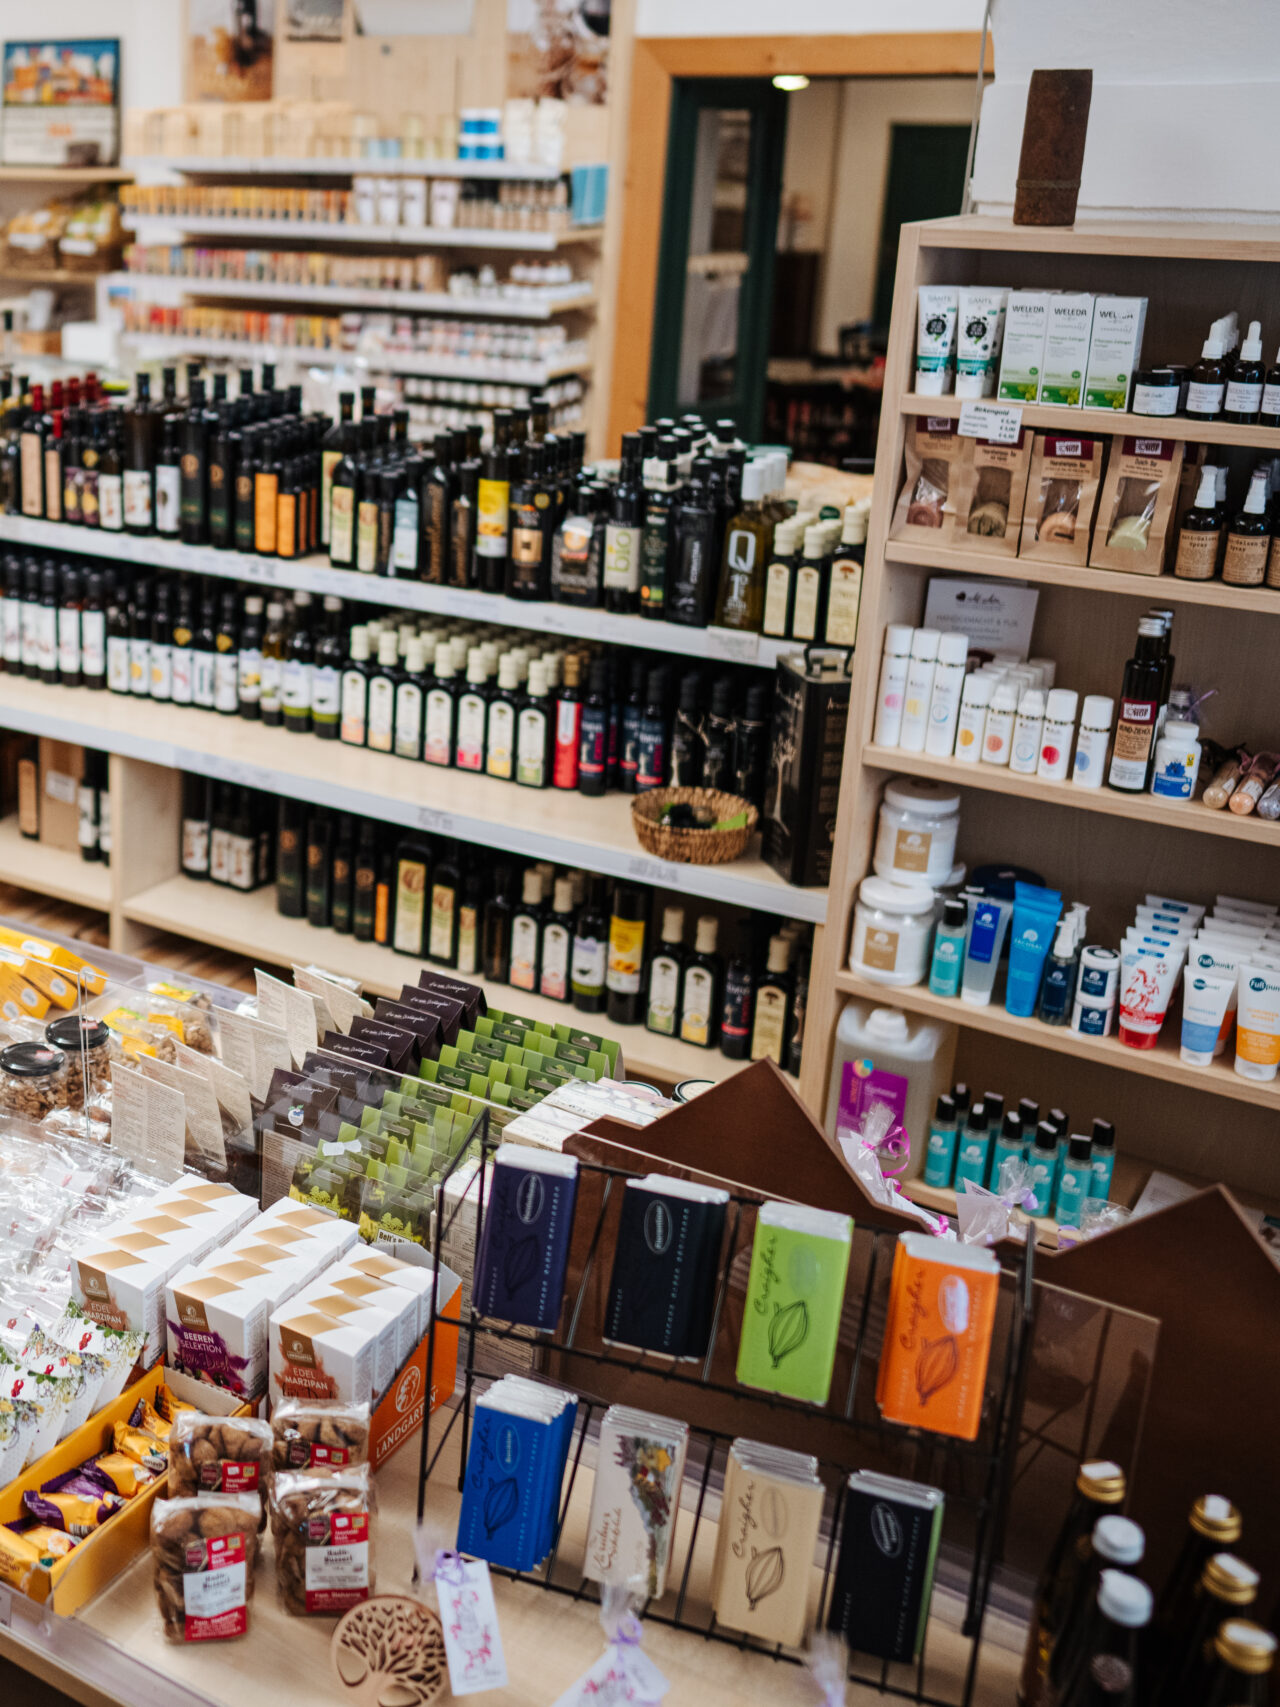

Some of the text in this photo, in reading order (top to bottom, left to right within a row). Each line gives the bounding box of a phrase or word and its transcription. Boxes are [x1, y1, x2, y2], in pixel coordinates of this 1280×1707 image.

[1012, 305, 1044, 313] WELEDA
[1054, 308, 1087, 316] WELEDA
[1100, 311, 1133, 320] WEL
[608, 531, 632, 573] bio
[91, 1303, 111, 1313] EDEL
[87, 1311, 121, 1324] MARZIPAN
[183, 1332, 215, 1344] BEEREN
[181, 1341, 222, 1354] SELEKTION
[293, 1367, 316, 1380] EDEL
[285, 1376, 328, 1390] MARZIPAN
[376, 1393, 437, 1459] LANDGARTN
[732, 1480, 758, 1559] Craigher
